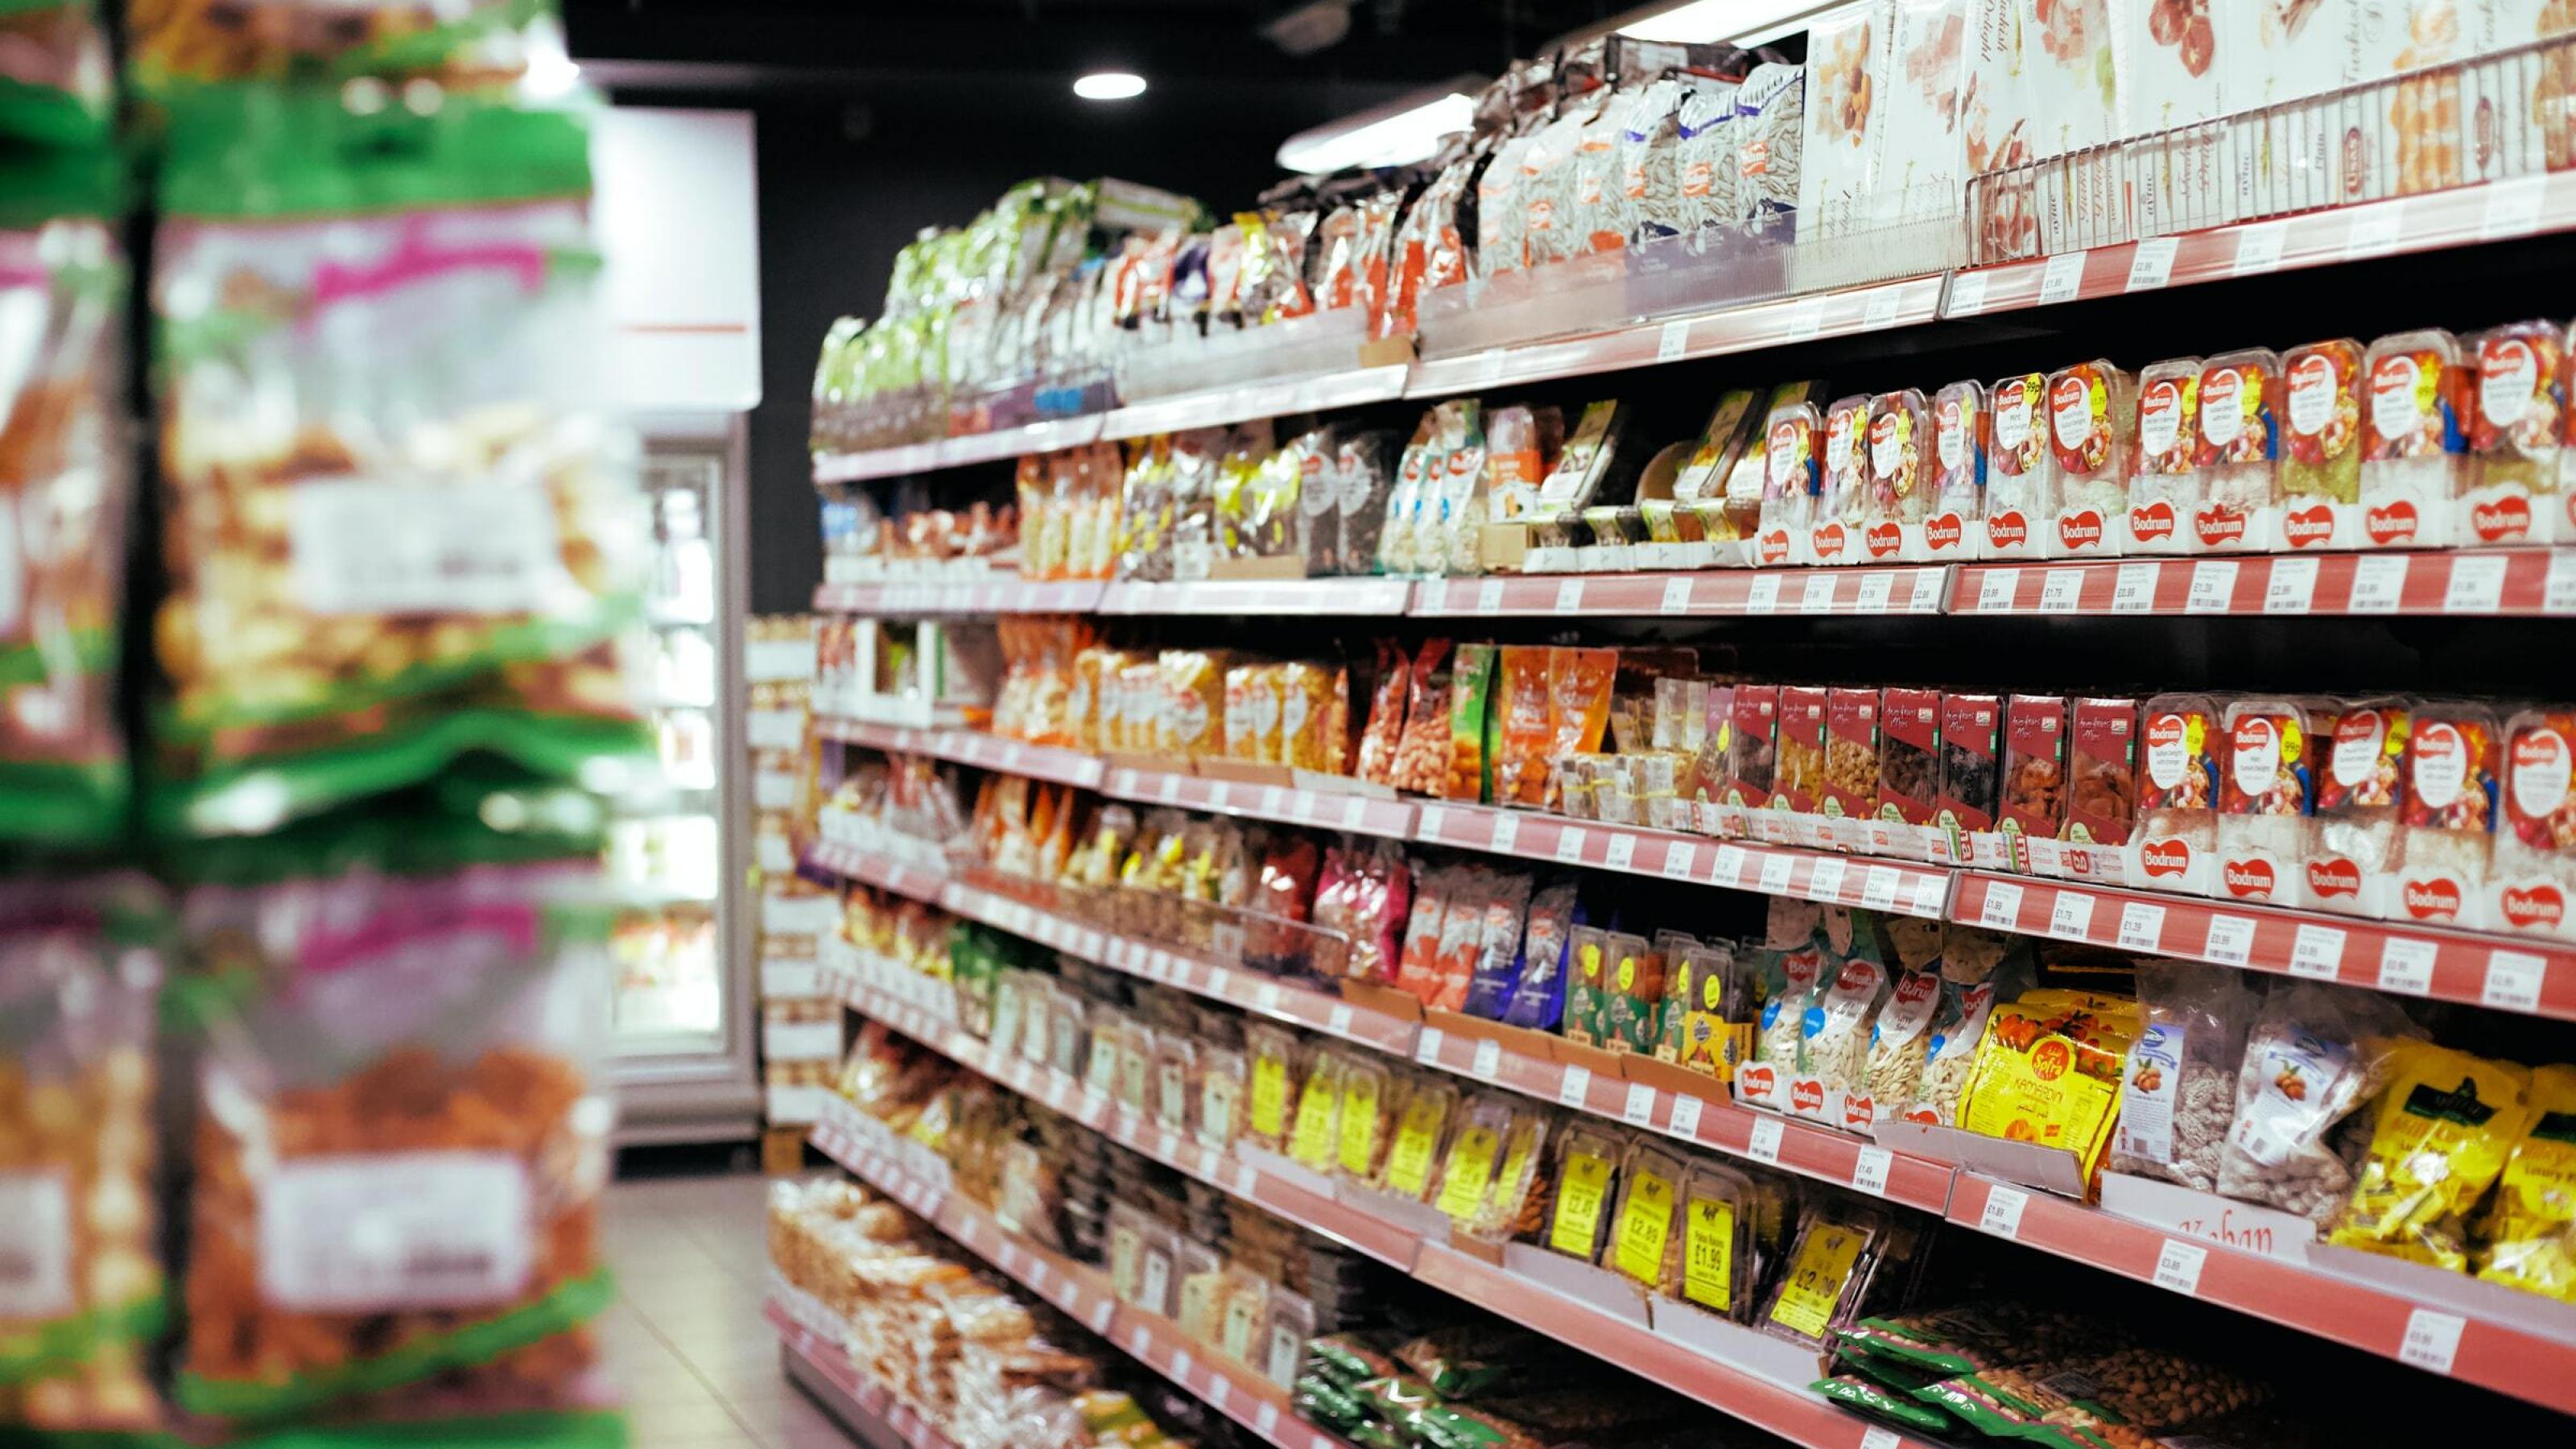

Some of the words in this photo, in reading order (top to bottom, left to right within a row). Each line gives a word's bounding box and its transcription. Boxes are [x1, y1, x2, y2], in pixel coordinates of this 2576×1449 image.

[1996, 0, 2010, 52] urkish
[2025, 382, 2041, 394] 99p
[1999, 392, 2022, 406] Bodrum
[2054, 390, 2081, 404] Bodrum
[2133, 516, 2172, 531] Bodrum
[2198, 519, 2242, 535] Bodrum
[2288, 519, 2331, 535] Bodrum
[2370, 514, 2415, 531] Bodrum
[2478, 511, 2528, 529] Bodrum
[1928, 525, 1959, 541] Bodrum
[1990, 524, 2024, 539] Bodrum
[2062, 524, 2099, 539] Bodrum
[1815, 535, 1843, 550] Bodrum
[1868, 533, 1900, 549] Bodrum
[2046, 588, 2062, 597] £1.79
[2149, 728, 2181, 741] Bodrum
[2236, 731, 2268, 744] Bodrum
[2145, 850, 2186, 868] Bodrum
[2227, 869, 2272, 888] Bodrum
[2311, 872, 2357, 888] Bodrum
[2409, 889, 2458, 909] Bodrum
[2508, 898, 2562, 918] Bodrum
[2035, 1054, 2062, 1075] Sofra
[1794, 1087, 1821, 1104] Bodrum
[1695, 1244, 1722, 1271] £1.99
